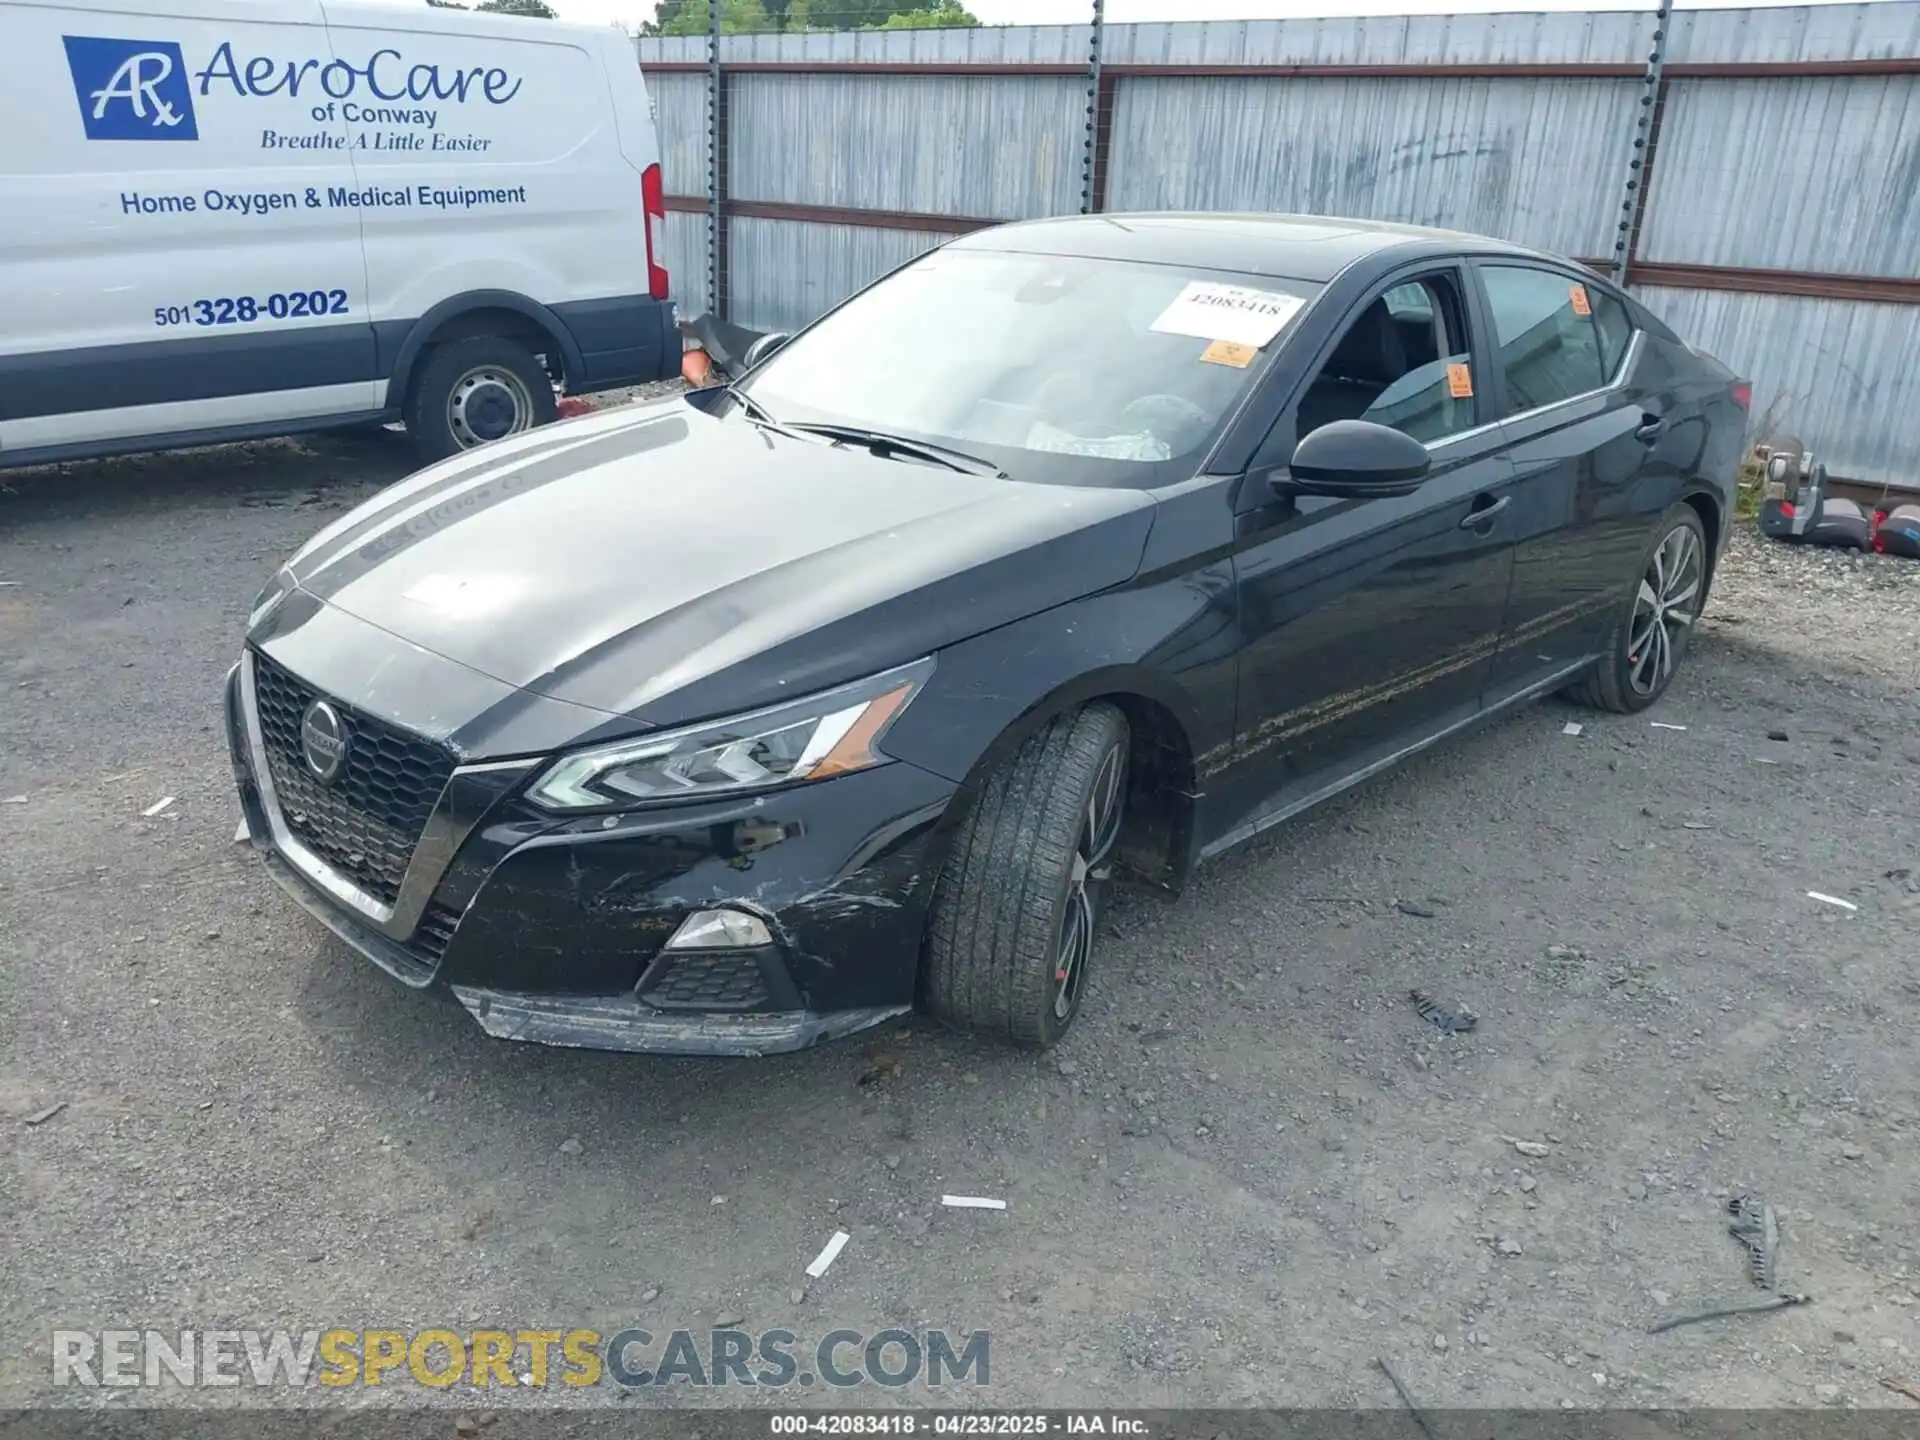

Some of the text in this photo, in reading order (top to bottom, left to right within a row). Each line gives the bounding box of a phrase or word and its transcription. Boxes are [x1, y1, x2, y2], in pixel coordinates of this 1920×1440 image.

[195, 41, 522, 105] AeroCare
[311, 102, 437, 128] of Conway
[261, 130, 492, 152] Breathe A Little Easier
[120, 185, 527, 215] Home Oxygen & Medical Equipment
